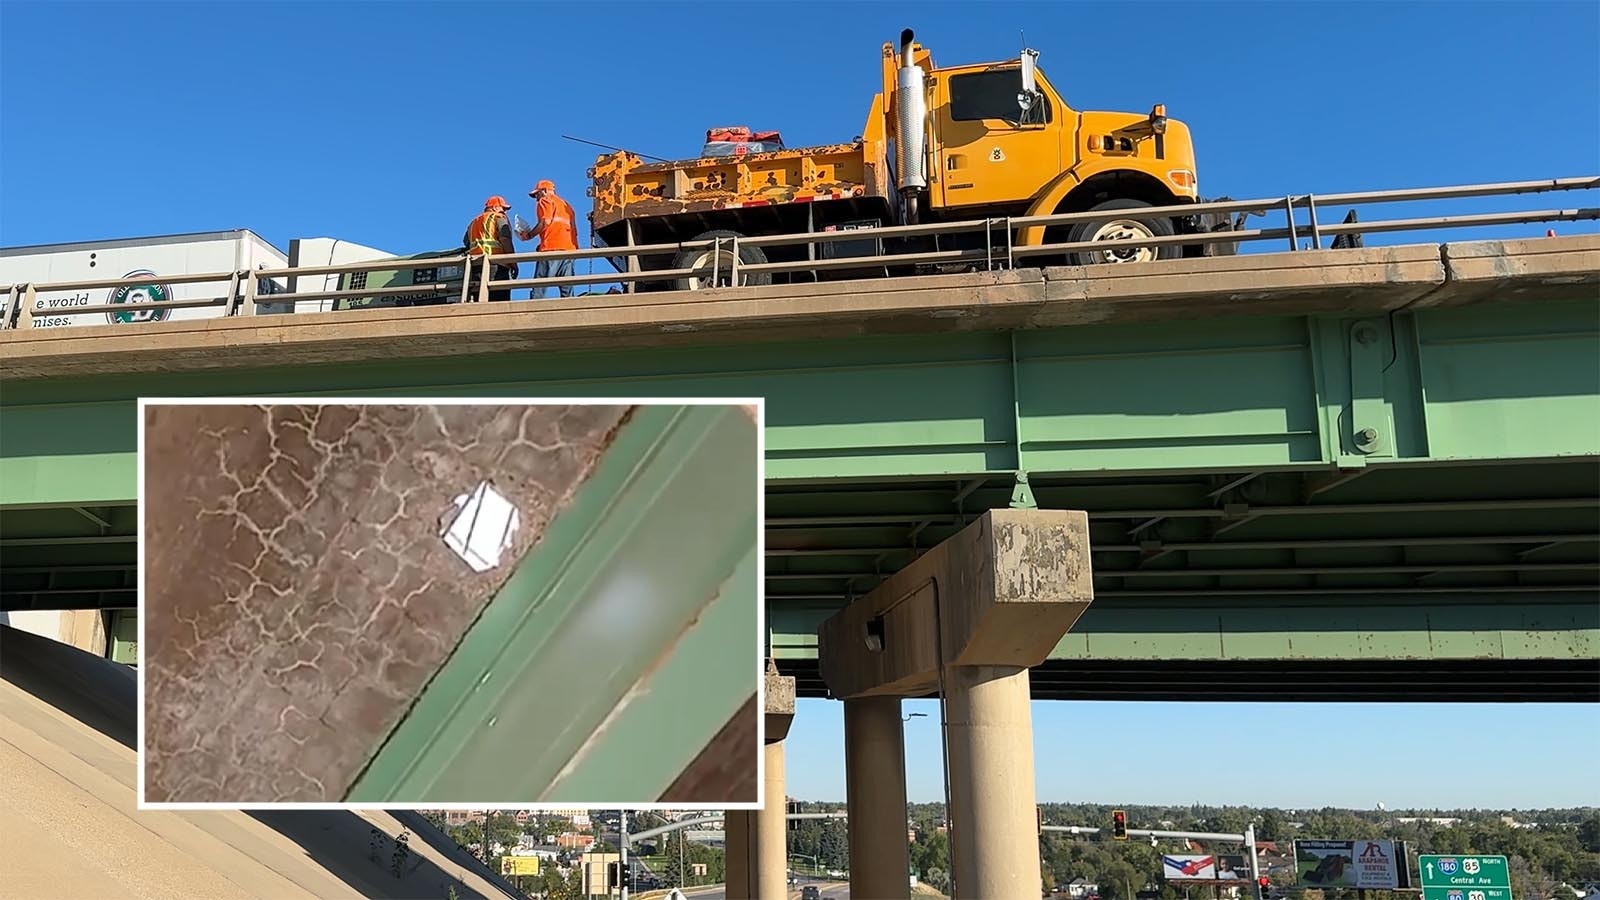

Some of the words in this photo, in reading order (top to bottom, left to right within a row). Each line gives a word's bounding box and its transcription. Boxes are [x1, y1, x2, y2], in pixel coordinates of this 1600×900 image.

[49, 293, 89, 307] world
[33, 315, 72, 327] mises.
[1440, 863, 1456, 871] 180
[1464, 861, 1479, 871] 85
